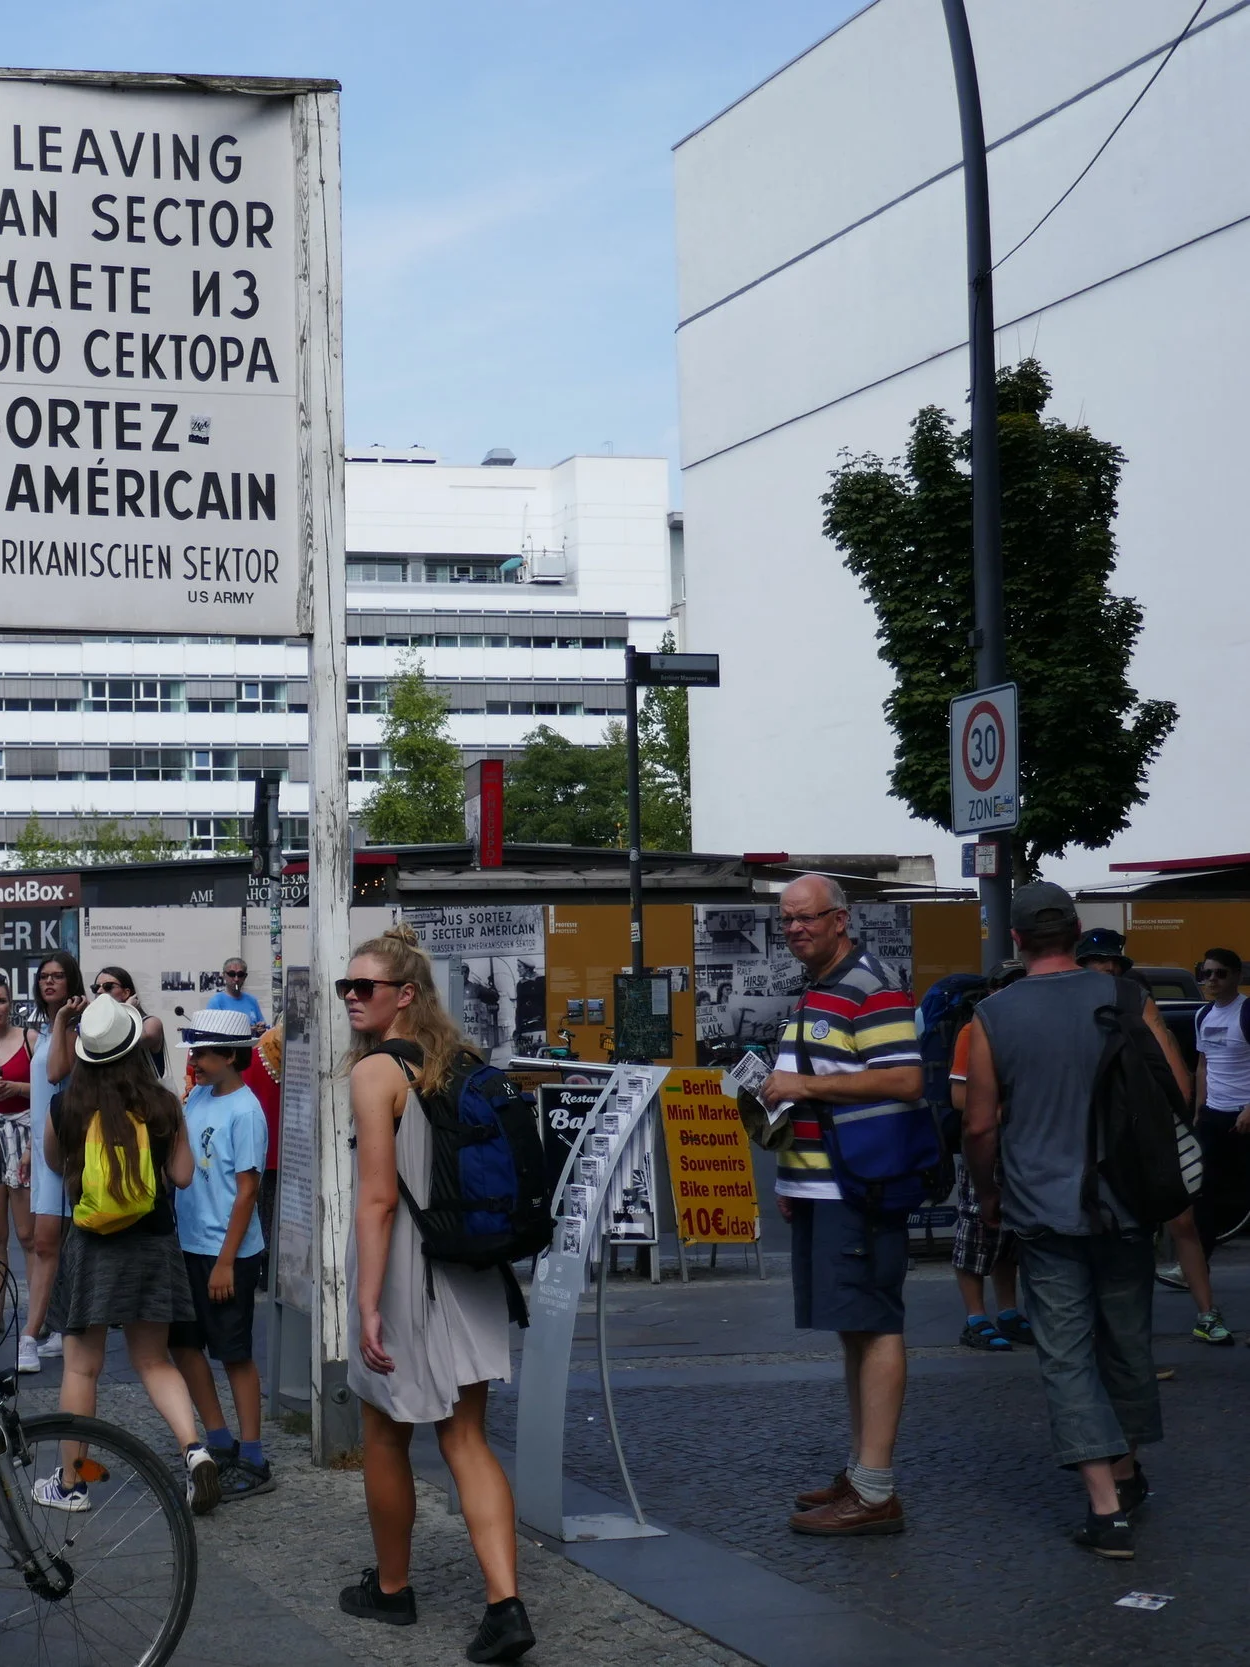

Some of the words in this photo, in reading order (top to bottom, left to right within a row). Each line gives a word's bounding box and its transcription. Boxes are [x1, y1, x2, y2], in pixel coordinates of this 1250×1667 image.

[14, 125, 241, 184] LEAVING
[92, 194, 273, 248] SECTOR
[193, 270, 259, 319] ИЗ
[84, 329, 279, 383] СЕКТОРА
[5, 458, 275, 520] AMÉRICAIN
[183, 546, 278, 583] SEKTOR
[188, 591, 208, 603] US
[214, 592, 254, 604] ARMY
[970, 724, 997, 768] 30
[968, 795, 1001, 822] ZONE
[469, 911, 513, 924] SORTEZ
[432, 927, 475, 940] SECTEUR
[701, 1023, 725, 1037] KALK
[682, 1079, 722, 1096] Berlin
[667, 1104, 695, 1121] Mini
[699, 1104, 740, 1121] Marke
[680, 1129, 739, 1147] Discount
[680, 1155, 746, 1172] Souvenirs
[680, 1180, 710, 1197] Bike
[713, 1181, 753, 1197] rental
[682, 1207, 756, 1240] 10€/day
